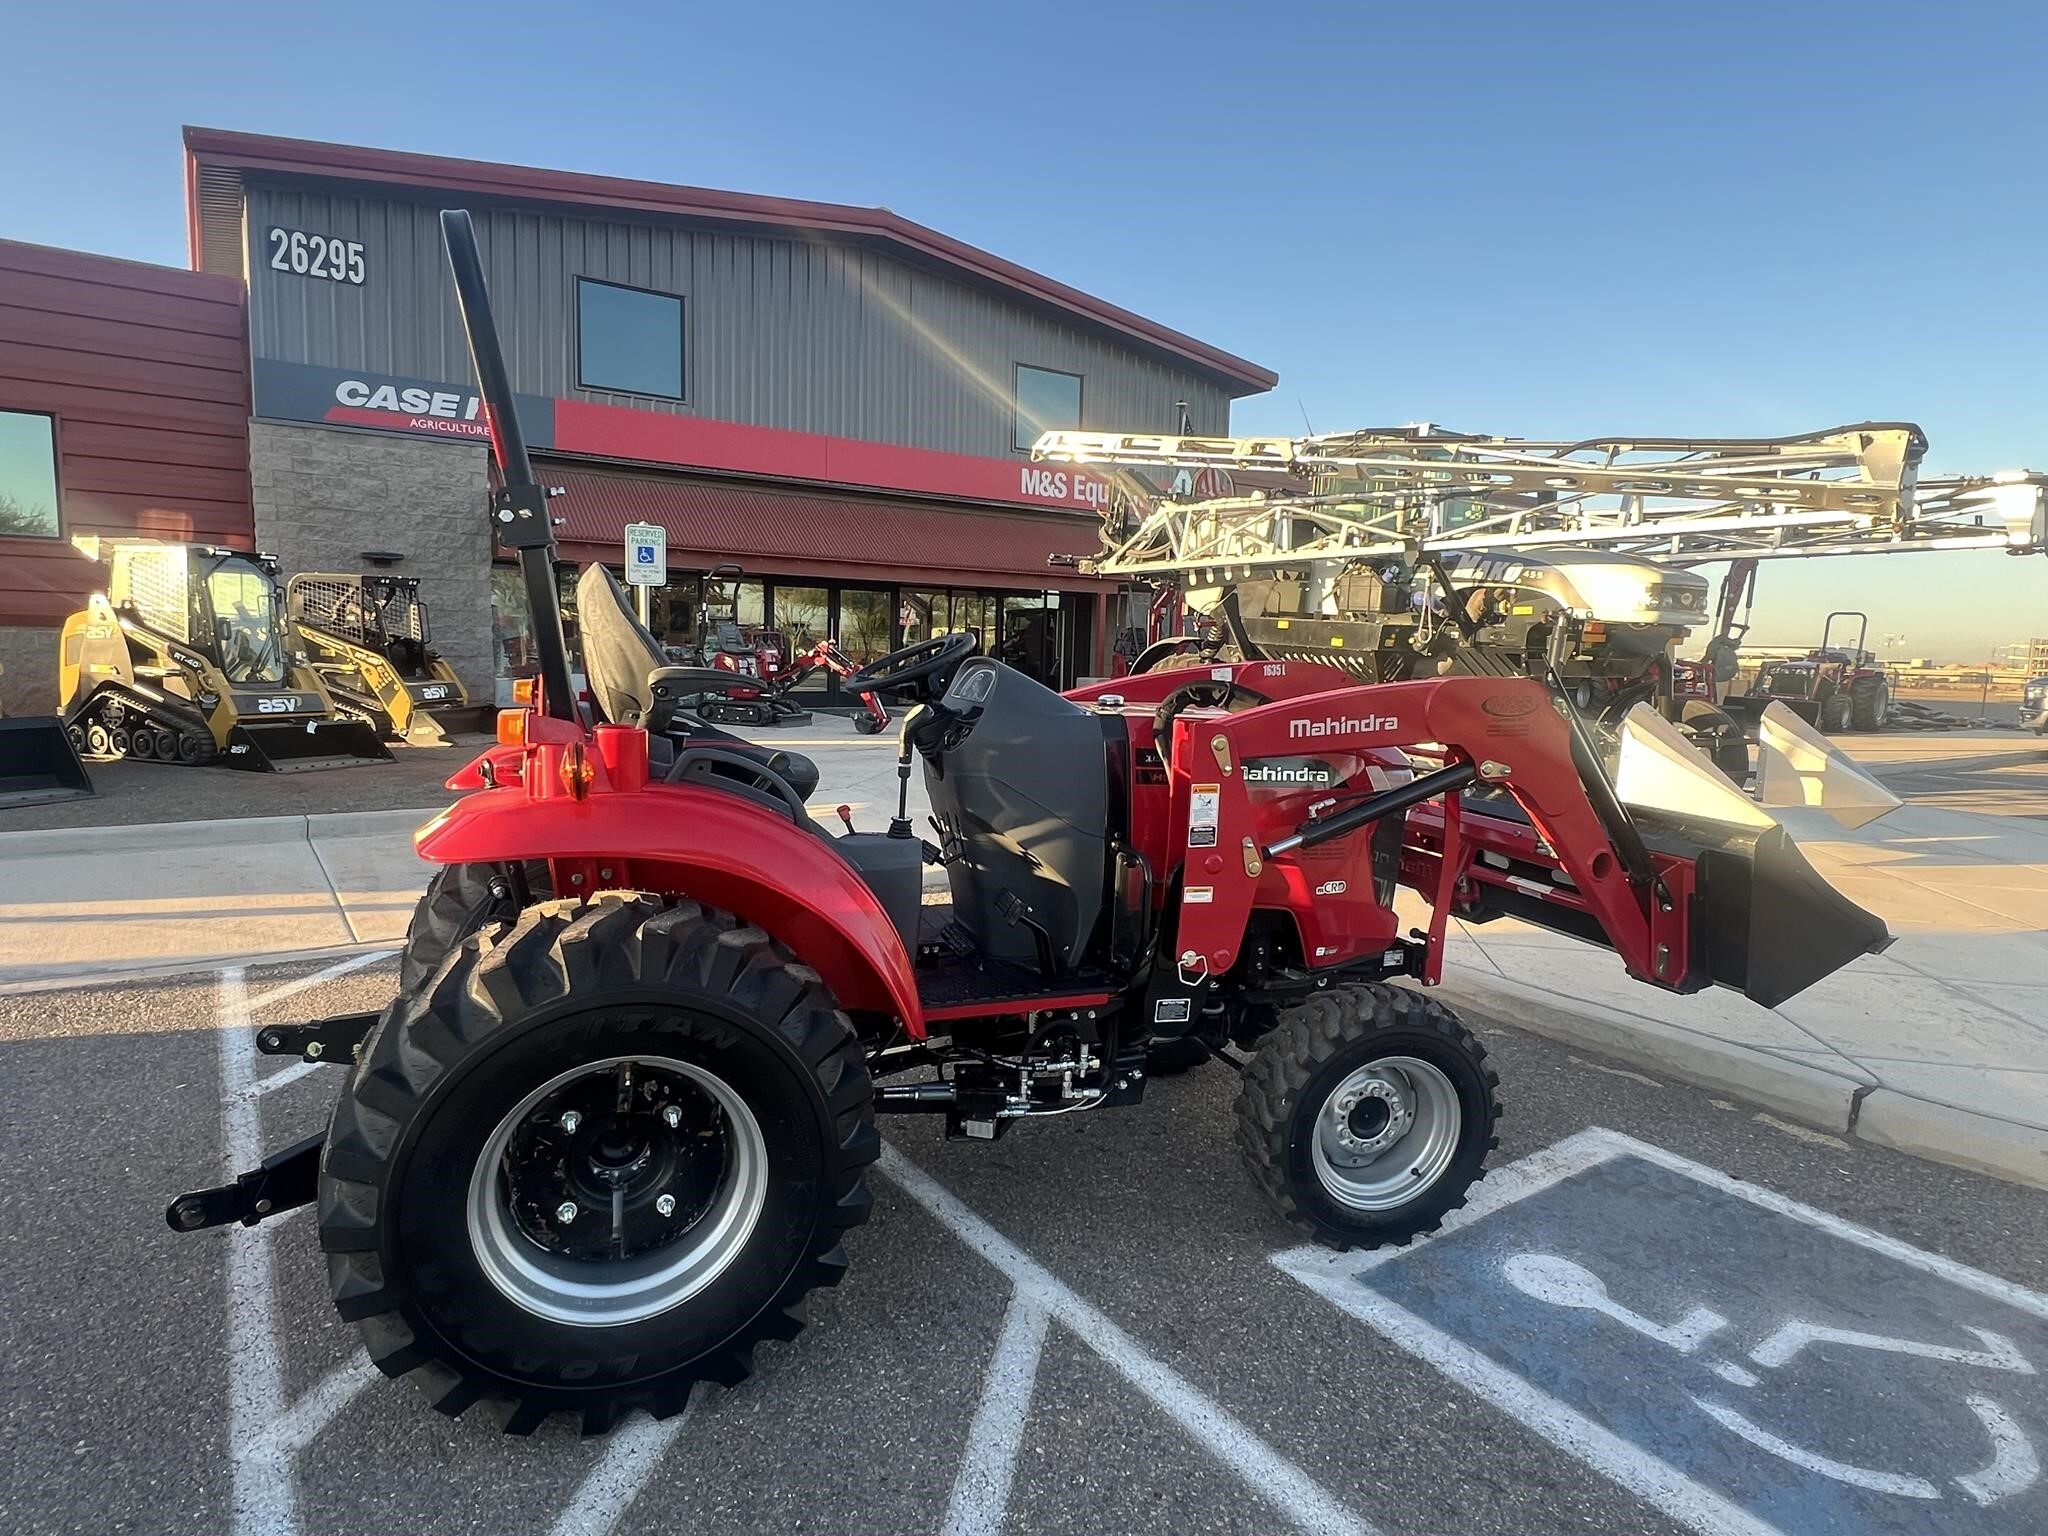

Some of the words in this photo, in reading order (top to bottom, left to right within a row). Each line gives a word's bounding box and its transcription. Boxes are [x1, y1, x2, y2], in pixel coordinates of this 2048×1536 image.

[270, 228, 365, 284] 26295
[335, 380, 460, 420] CASE
[409, 418, 491, 436] AGRICULTURE
[1021, 468, 1067, 498] M&S
[1073, 475, 1109, 508] Equ
[630, 529, 663, 538] RESERVED
[631, 537, 661, 546] PARKING
[1451, 552, 1524, 583] MAKO
[1289, 714, 1398, 738] Mahindra
